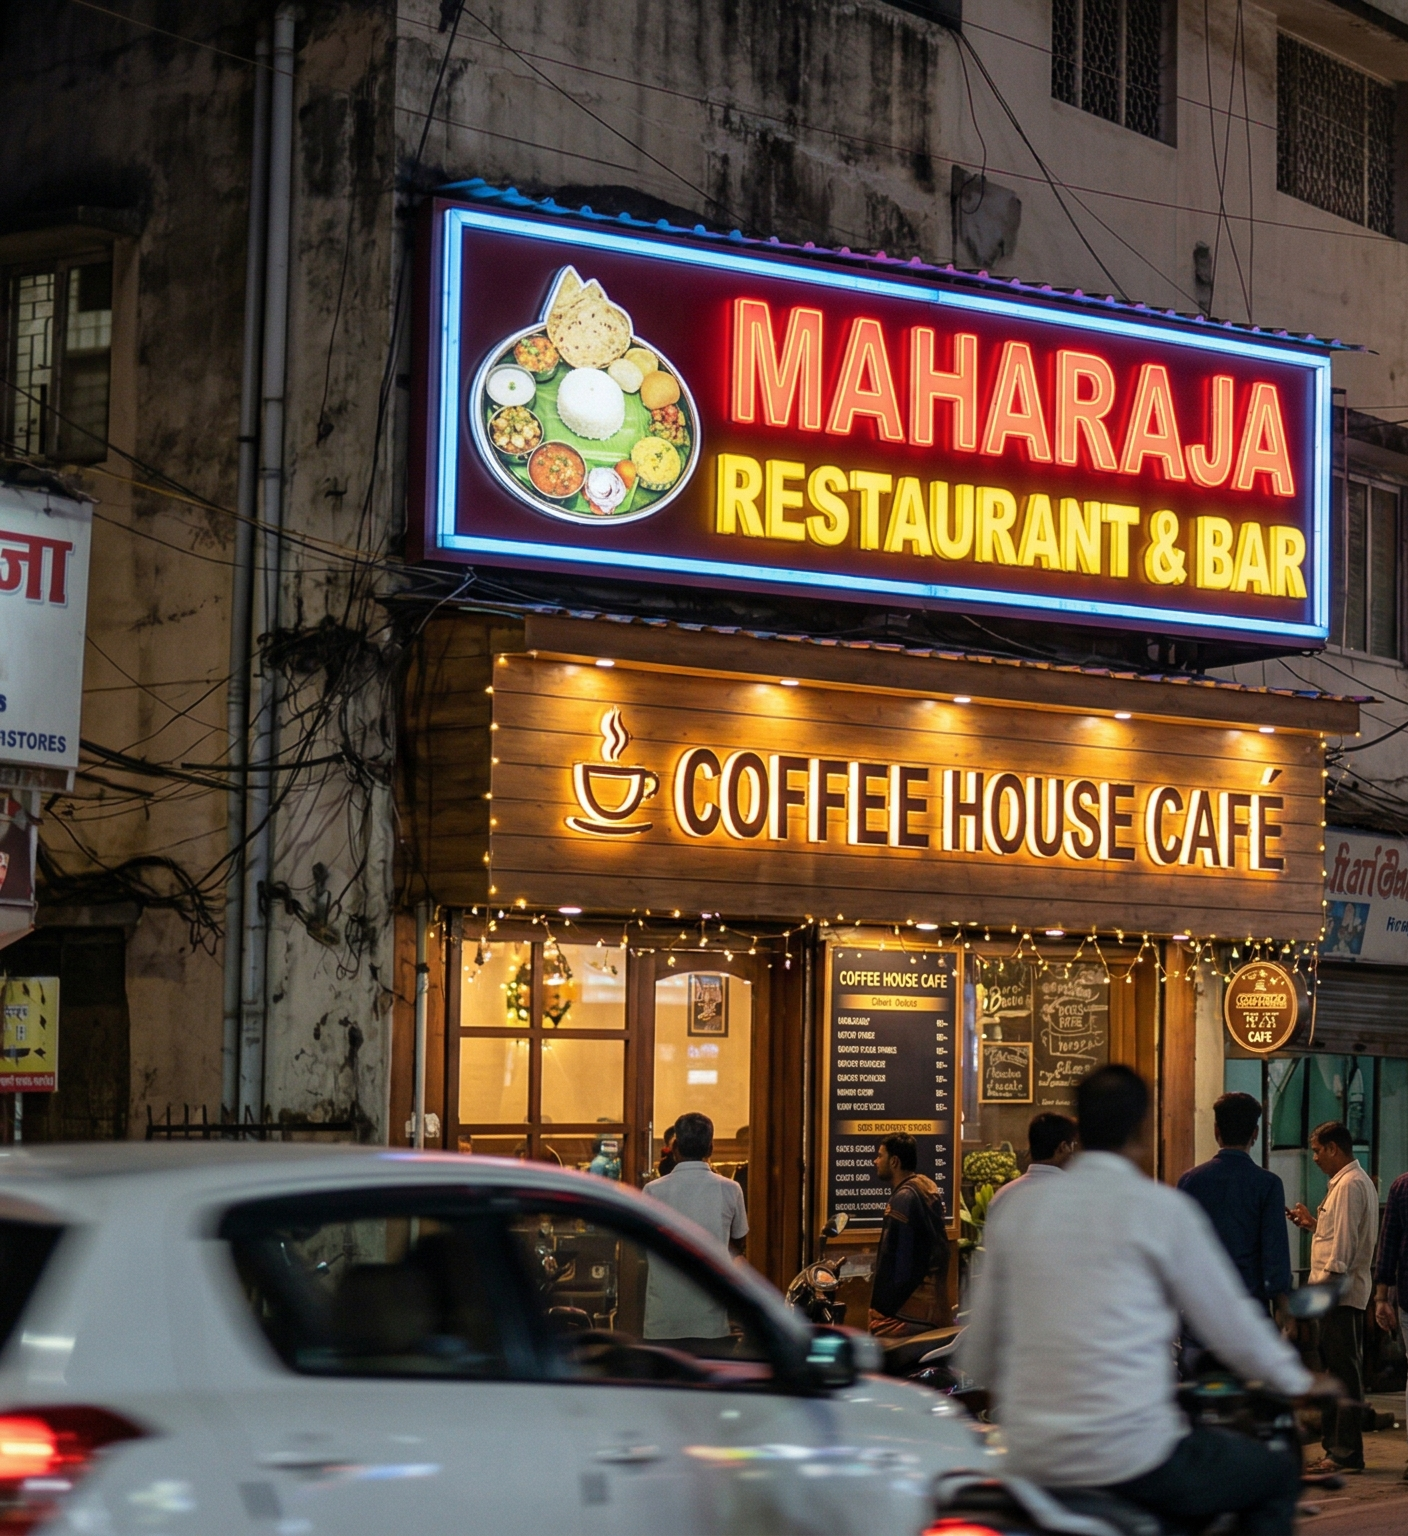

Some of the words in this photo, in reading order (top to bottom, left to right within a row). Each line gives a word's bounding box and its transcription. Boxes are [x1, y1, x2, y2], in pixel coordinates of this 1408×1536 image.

[731, 296, 1297, 498] MAHARAJA
[715, 452, 1141, 579] RESTAURANT
[1143, 508, 1187, 586] &
[1196, 515, 1308, 599] BAR
[674, 747, 931, 849] COFFEE
[942, 769, 1137, 863] HOUSE
[1143, 768, 1286, 872] CAFÉ
[840, 970, 881, 987] COFFEE
[883, 972, 919, 988] HOUSE
[921, 974, 948, 989] CAFE
[1248, 1031, 1273, 1043] CAFE
